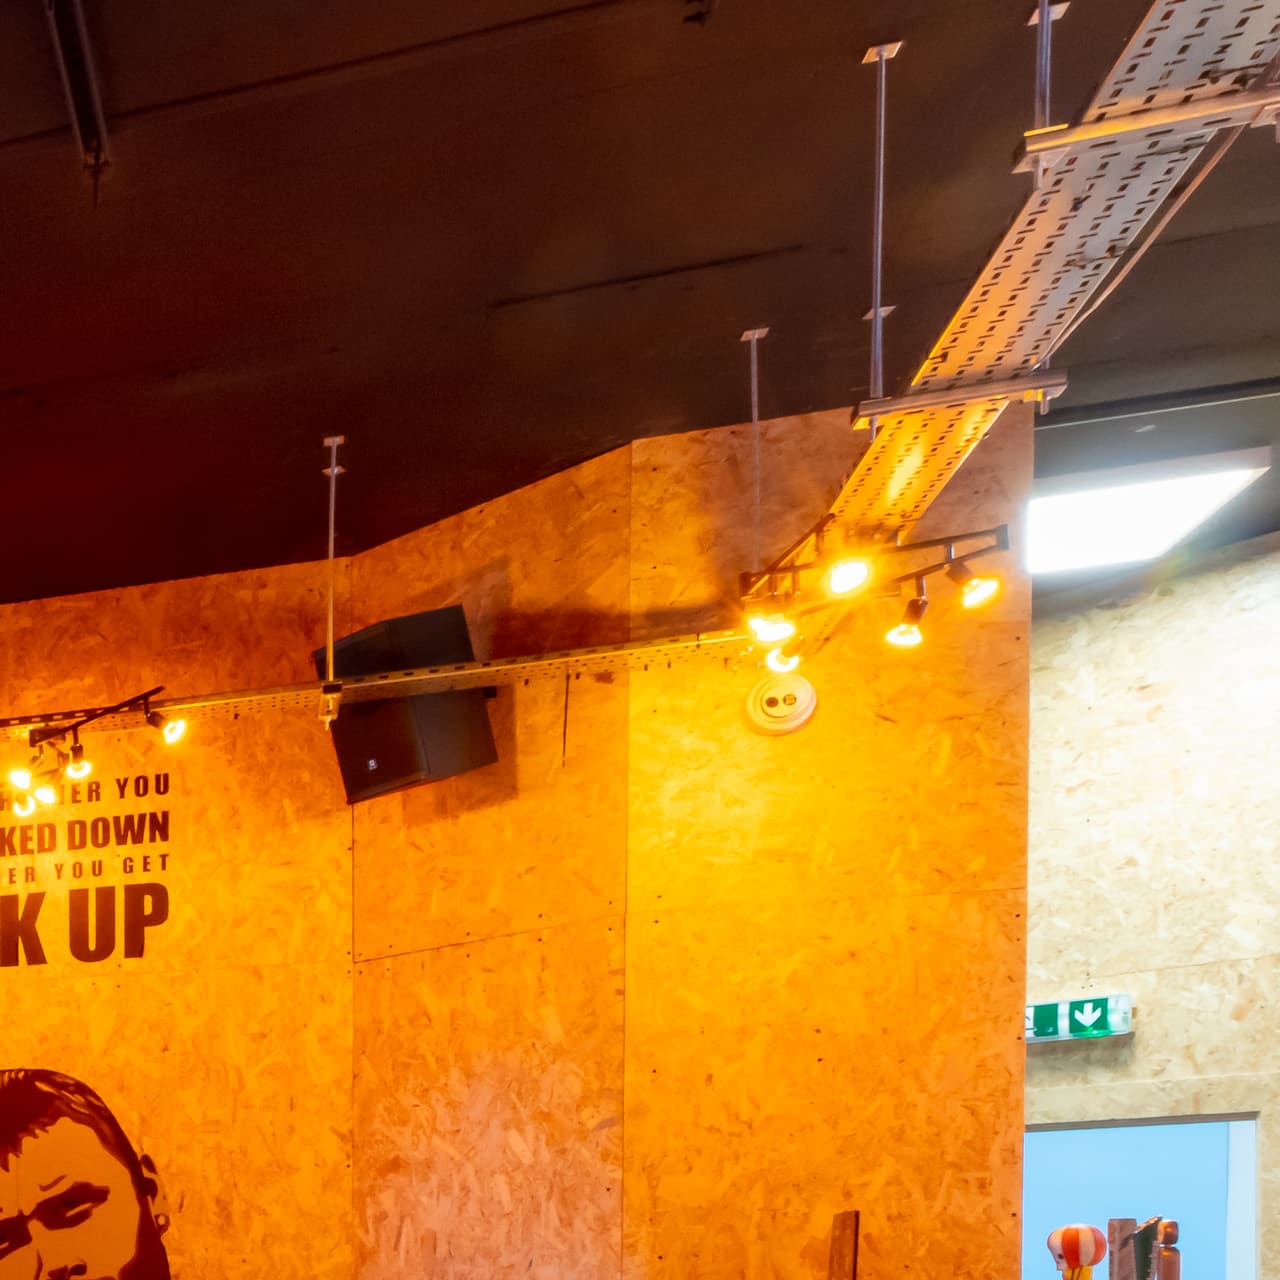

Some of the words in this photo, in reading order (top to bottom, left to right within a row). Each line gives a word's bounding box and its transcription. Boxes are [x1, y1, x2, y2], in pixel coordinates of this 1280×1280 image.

[115, 772, 170, 799] YOU
[67, 810, 170, 851] DOWN
[54, 860, 103, 880] YOU
[123, 853, 170, 874] GET
[68, 882, 170, 963] UP
